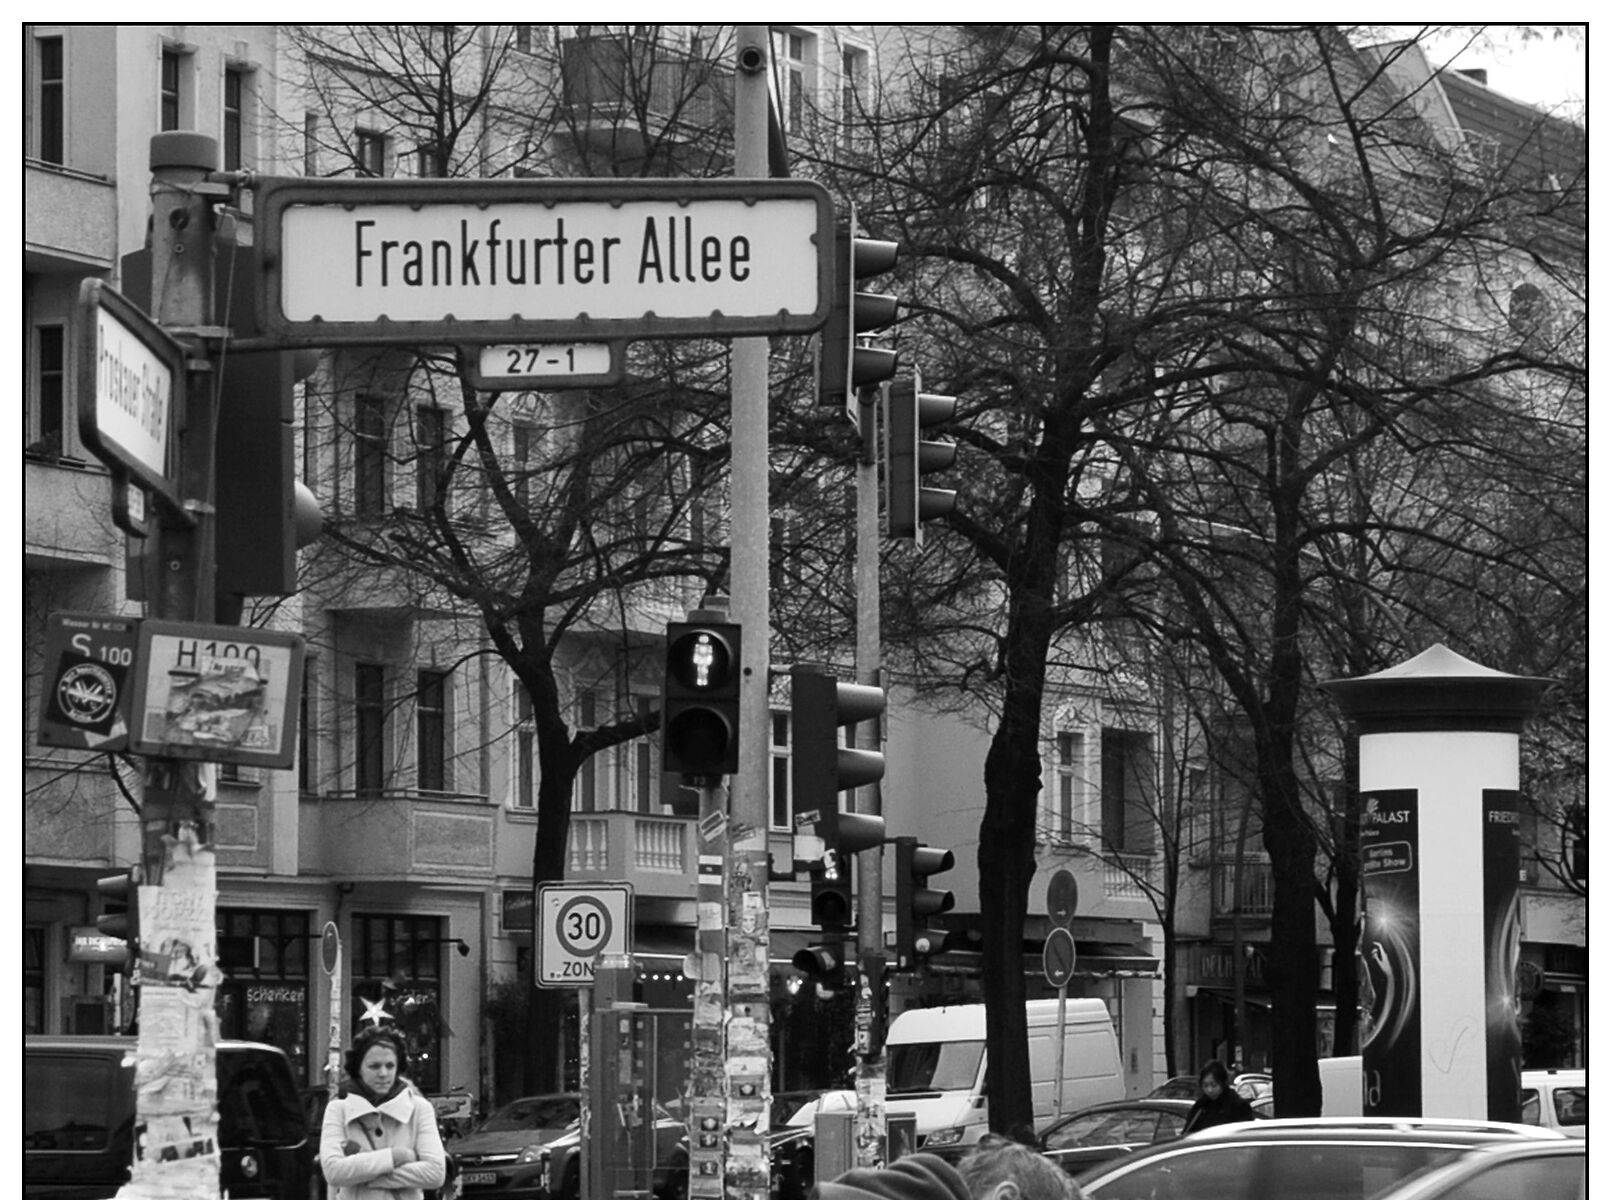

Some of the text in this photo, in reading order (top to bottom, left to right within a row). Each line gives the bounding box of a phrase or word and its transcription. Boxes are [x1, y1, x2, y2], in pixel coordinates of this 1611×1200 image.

[355, 215, 751, 287] Frankfurter Allee
[100, 645, 132, 666] 100
[567, 911, 601, 941] 30
[562, 961, 595, 977] ZON
